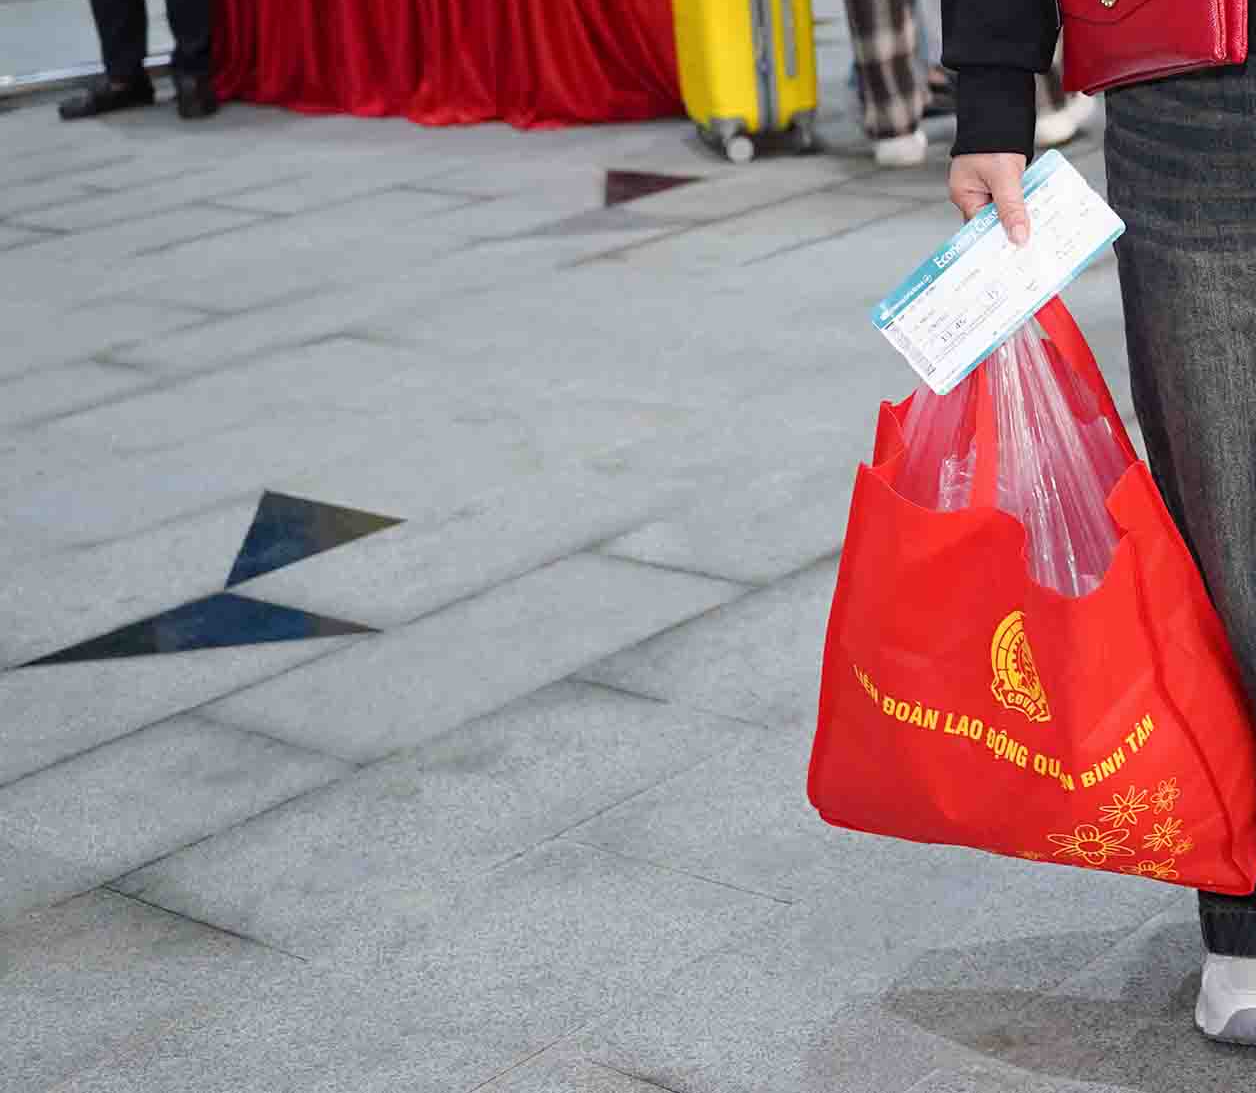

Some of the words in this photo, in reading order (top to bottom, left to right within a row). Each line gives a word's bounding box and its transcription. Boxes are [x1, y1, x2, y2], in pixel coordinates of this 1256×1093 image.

[883, 695, 939, 730] ĐOÀN
[944, 713, 984, 740] LAO
[986, 726, 1028, 768] ĐỘNG
[1034, 754, 1075, 791] QUN
[1080, 747, 1126, 788] BÌNH
[1125, 713, 1154, 753] TÂN
